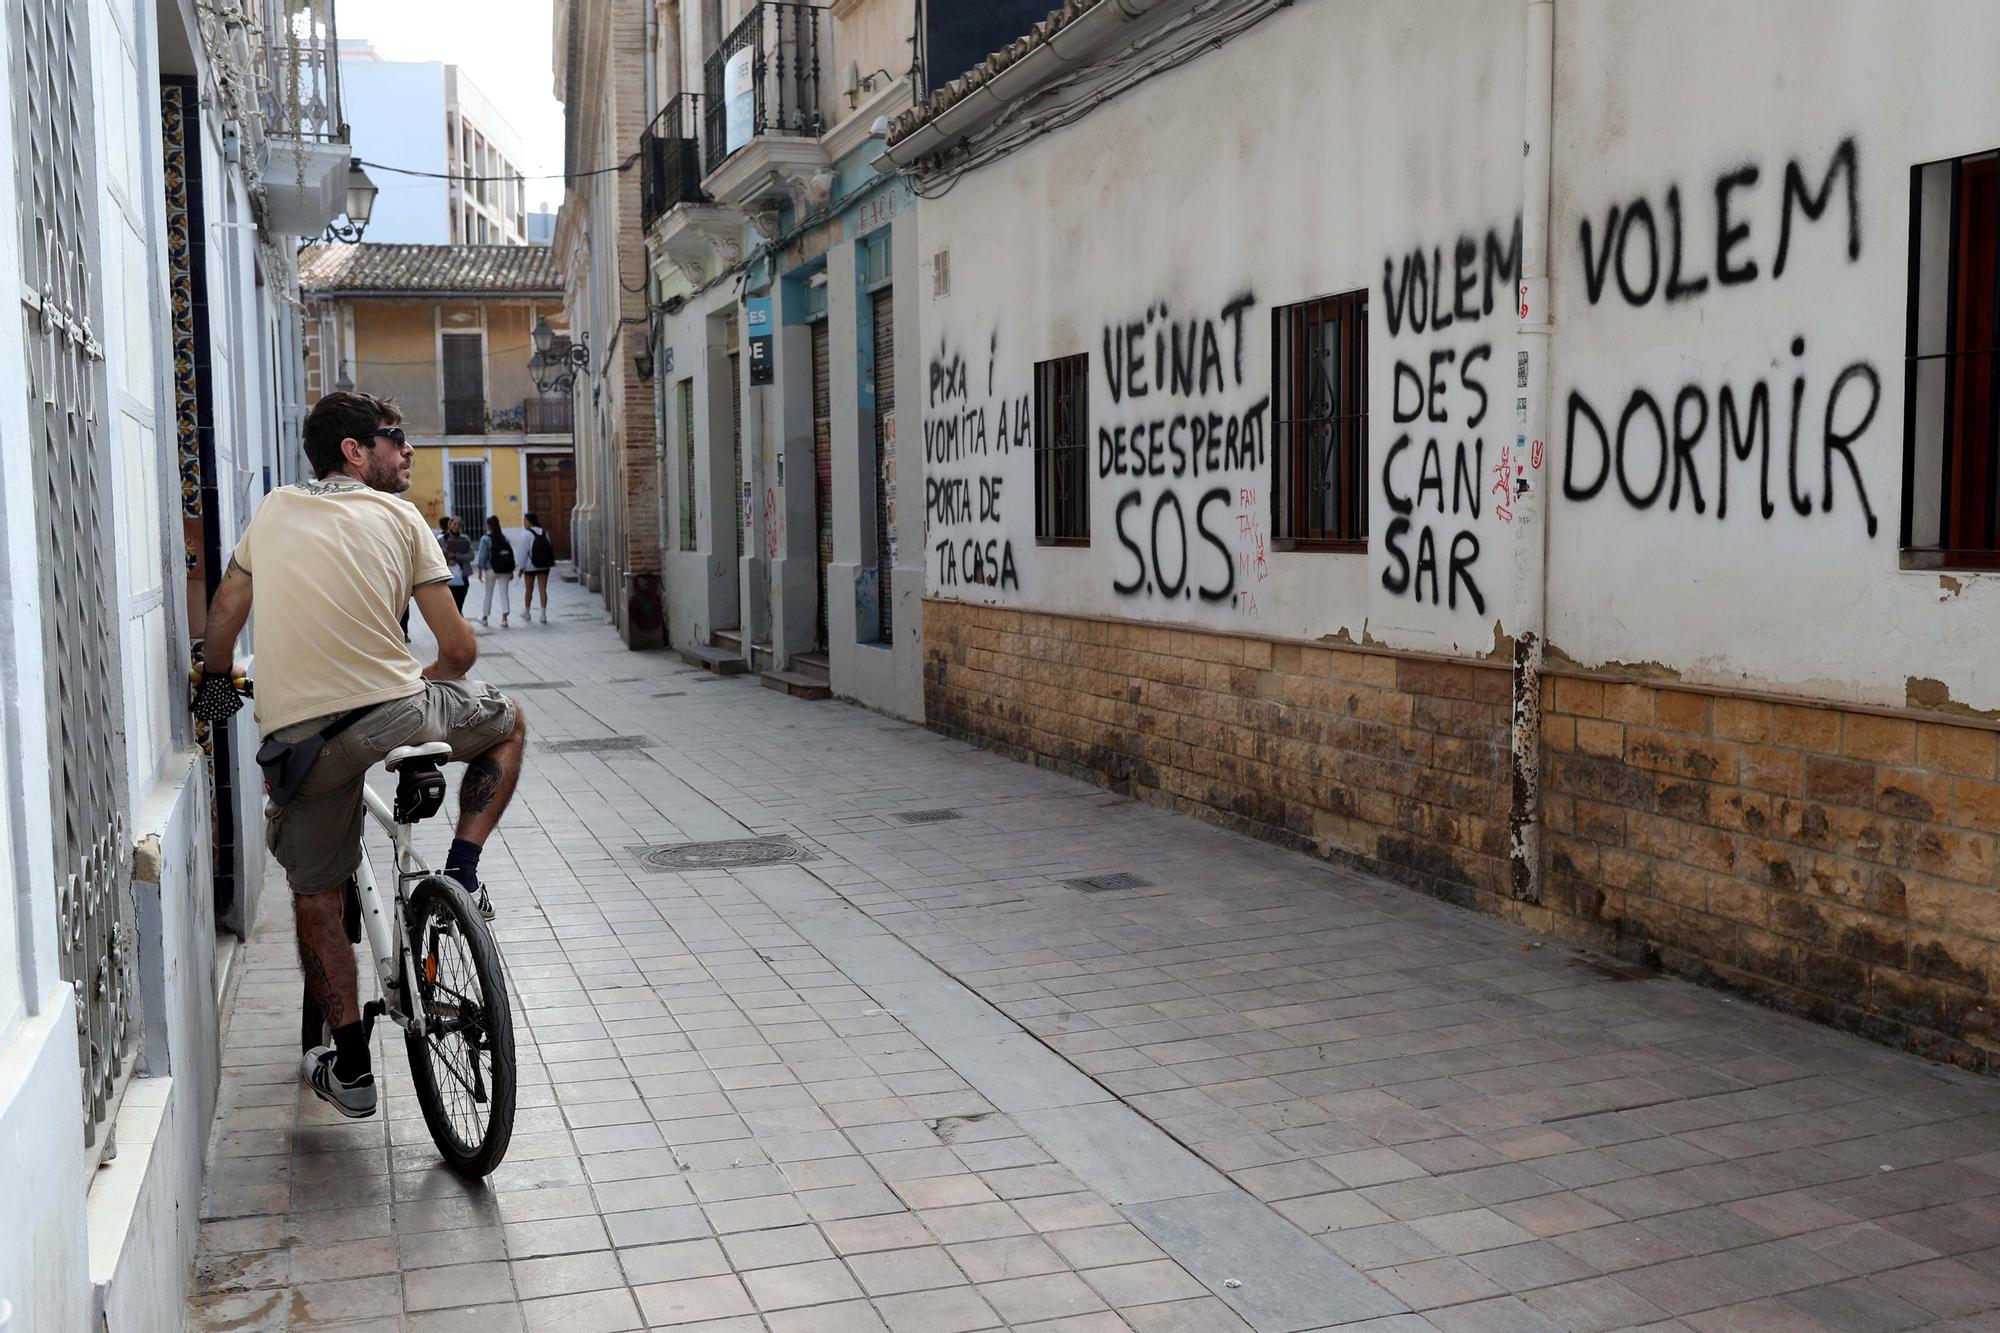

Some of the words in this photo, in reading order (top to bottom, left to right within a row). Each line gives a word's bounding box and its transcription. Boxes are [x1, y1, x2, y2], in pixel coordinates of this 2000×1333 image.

[1580, 134, 1862, 307] VOLEM
[1383, 212, 1522, 338] VOLEM
[996, 400, 1009, 456] A
[1013, 395, 1032, 449] LA
[1393, 343, 1491, 430] DES
[1098, 397, 1271, 480] DESESPERAT
[1382, 433, 1484, 521] CAN
[925, 477, 973, 534] PORTA
[979, 476, 1003, 523] DE
[935, 538, 957, 587] TA
[962, 538, 1020, 591] CASA
[1240, 591, 1259, 620] TA
[1381, 518, 1486, 617] SAR
